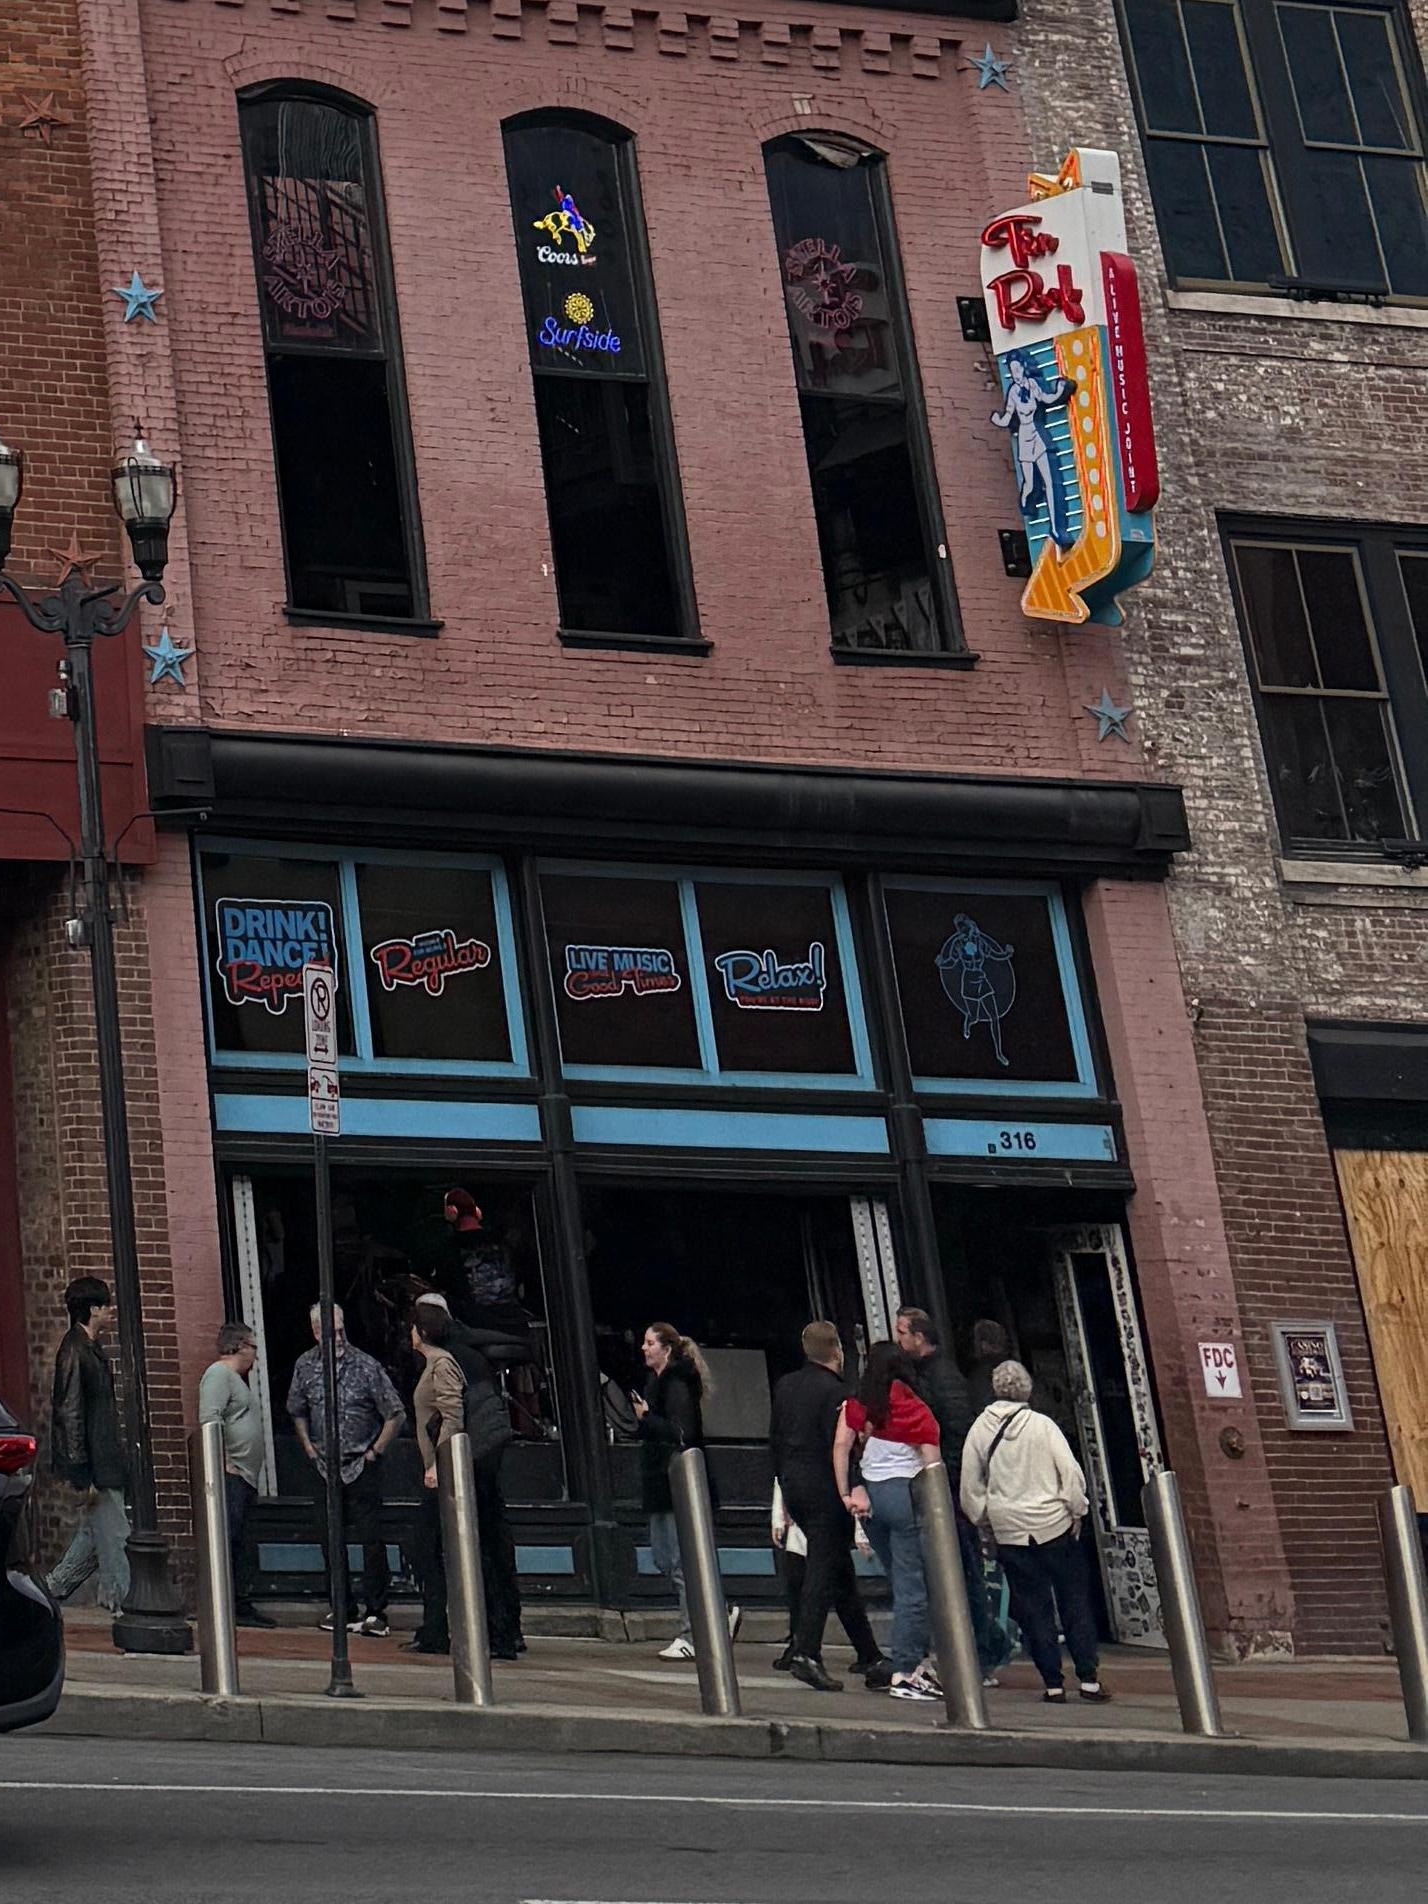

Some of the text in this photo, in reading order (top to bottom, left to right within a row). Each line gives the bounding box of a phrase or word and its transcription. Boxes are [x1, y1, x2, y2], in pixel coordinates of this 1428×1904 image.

[537, 245, 579, 266] Coors
[540, 316, 621, 353] Surfside
[1115, 345, 1128, 415] MUSIC
[1125, 422, 1136, 493] JOINT
[224, 907, 327, 940] DRINK!
[376, 931, 487, 992] Regular
[569, 950, 671, 973] LIVE MUSIC
[720, 945, 823, 996] Relax!
[227, 959, 306, 1005] Repe
[568, 971, 620, 994] Good
[1000, 1131, 1036, 1150] 316
[1202, 1347, 1234, 1369] FDC
